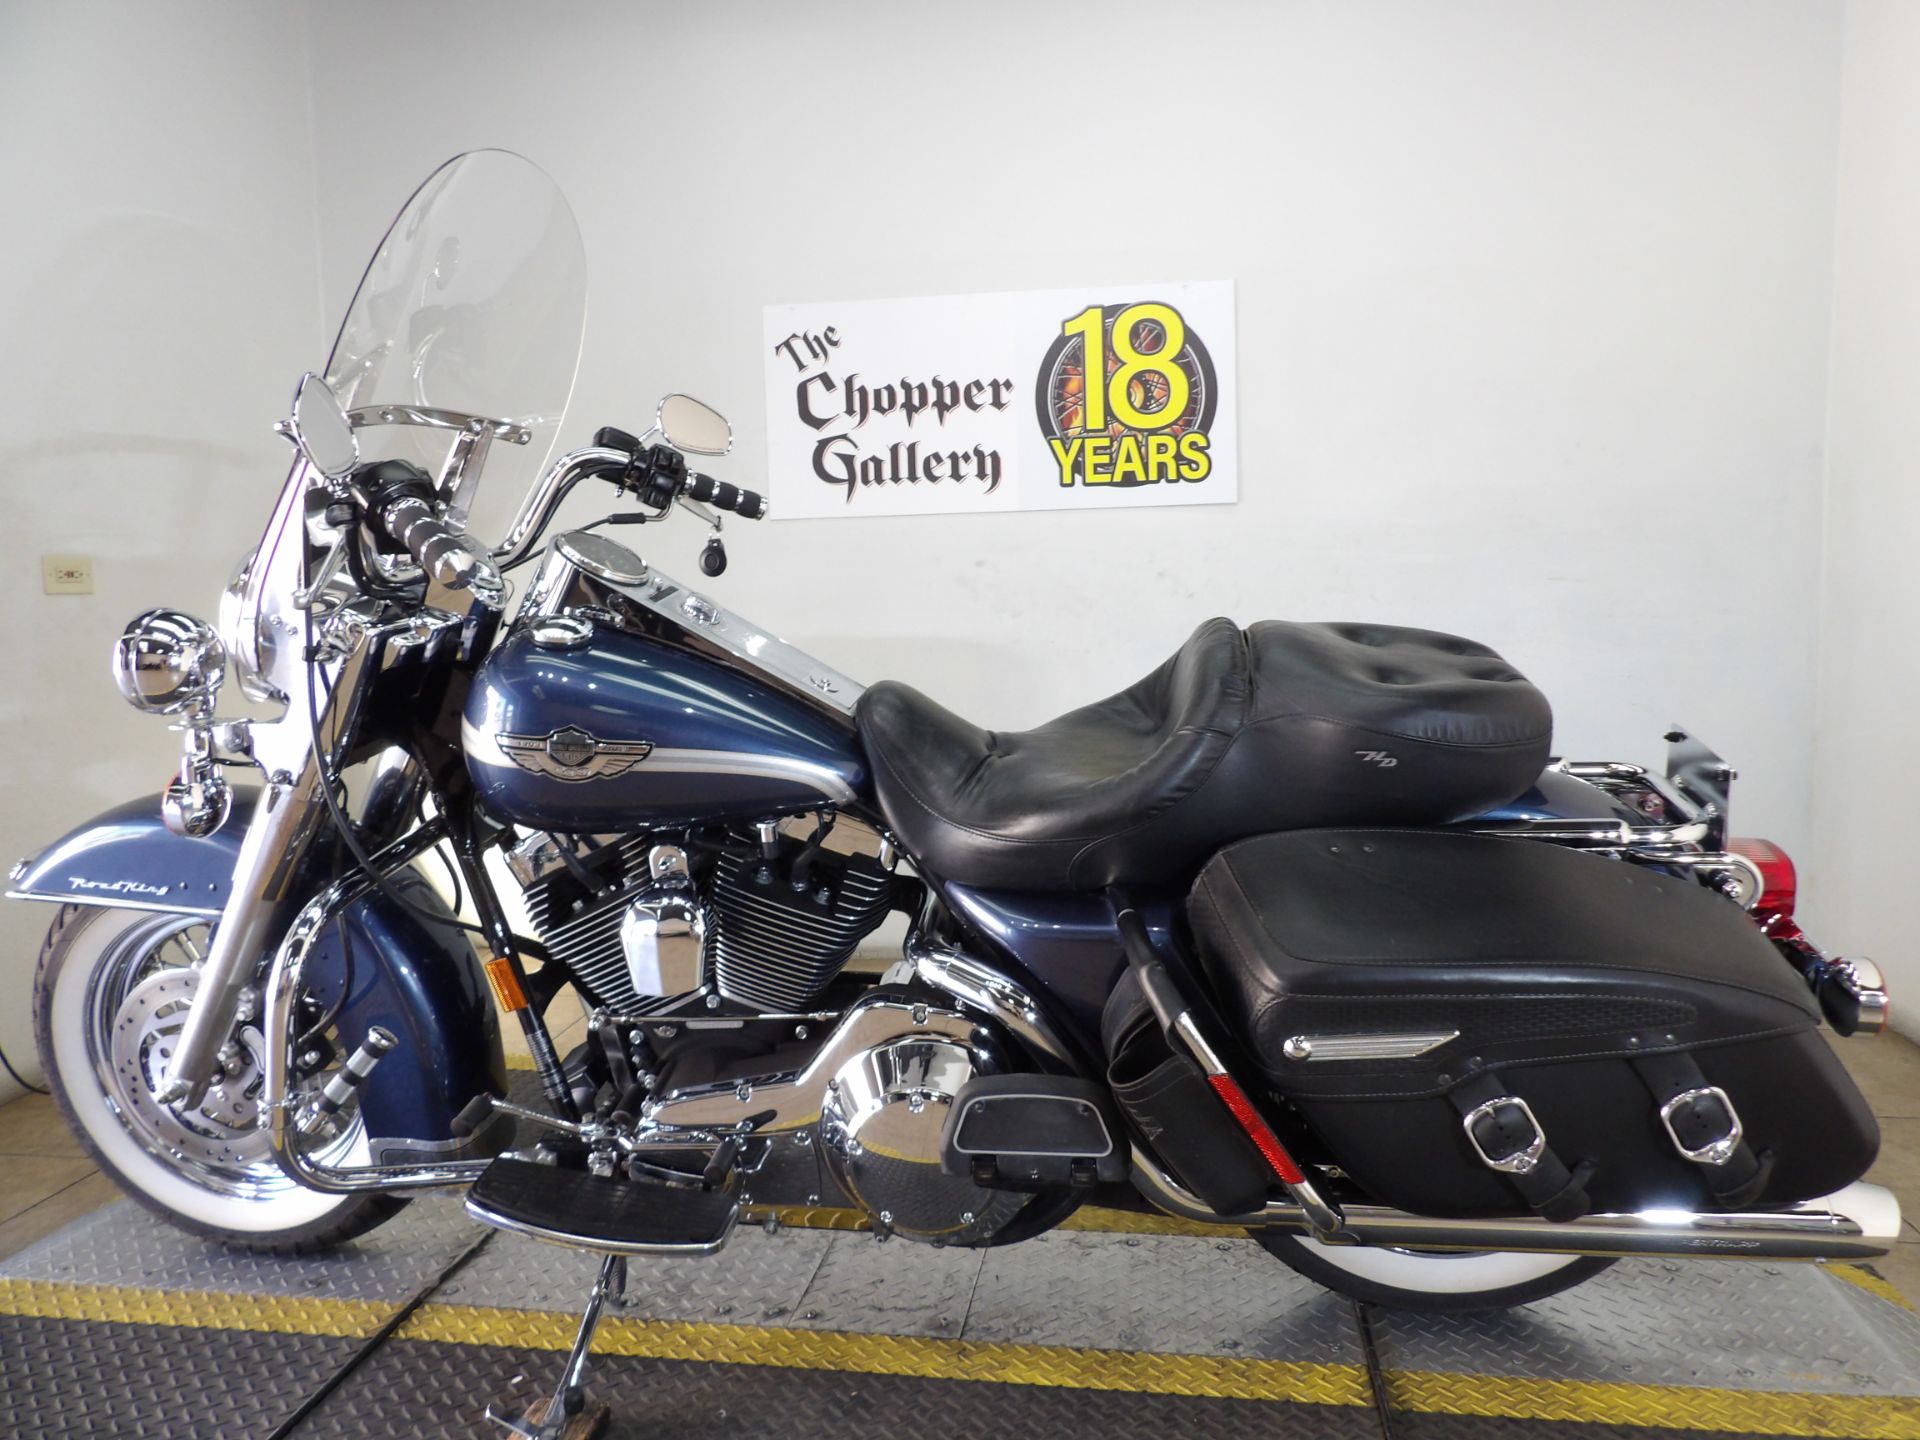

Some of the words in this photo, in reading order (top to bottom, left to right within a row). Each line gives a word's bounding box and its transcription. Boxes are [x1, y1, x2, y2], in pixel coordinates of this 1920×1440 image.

[775, 324, 841, 373] The
[1061, 301, 1191, 432] 18
[796, 370, 1015, 431] Chopper
[812, 433, 1001, 504] Gallery
[1049, 431, 1211, 486] YEARS
